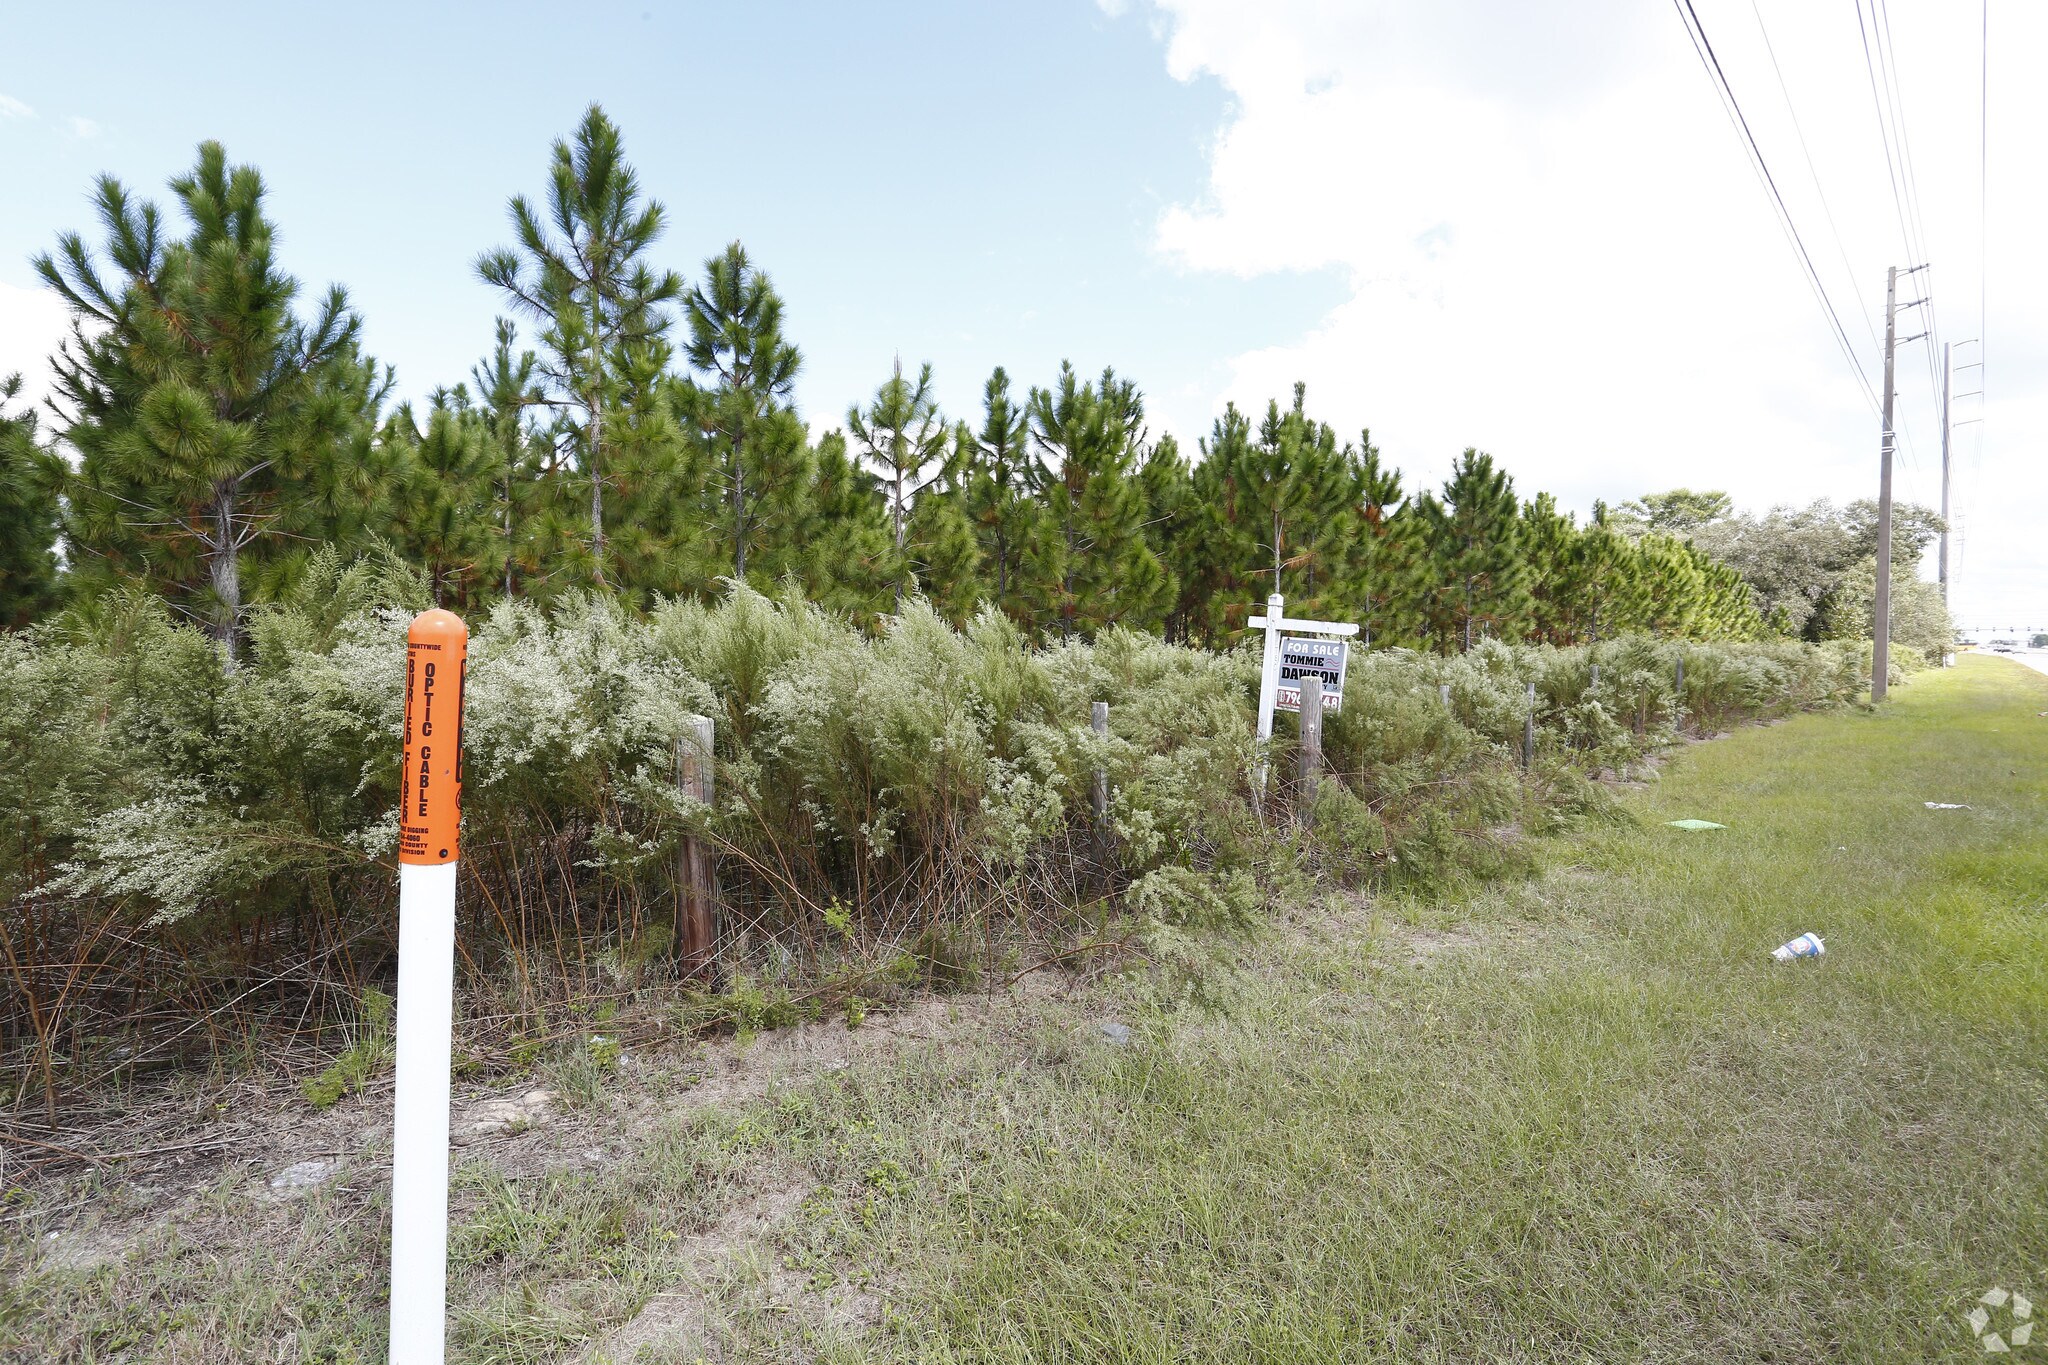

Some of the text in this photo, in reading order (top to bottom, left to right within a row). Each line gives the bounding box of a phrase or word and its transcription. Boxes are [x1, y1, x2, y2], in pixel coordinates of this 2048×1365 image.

[1284, 654, 1325, 666] TOMMIE
[1287, 643, 1339, 656] FOR SALE
[406, 659, 415, 745] BURIED
[419, 663, 436, 816] OPTIC CABLE
[402, 752, 411, 823] FIBER
